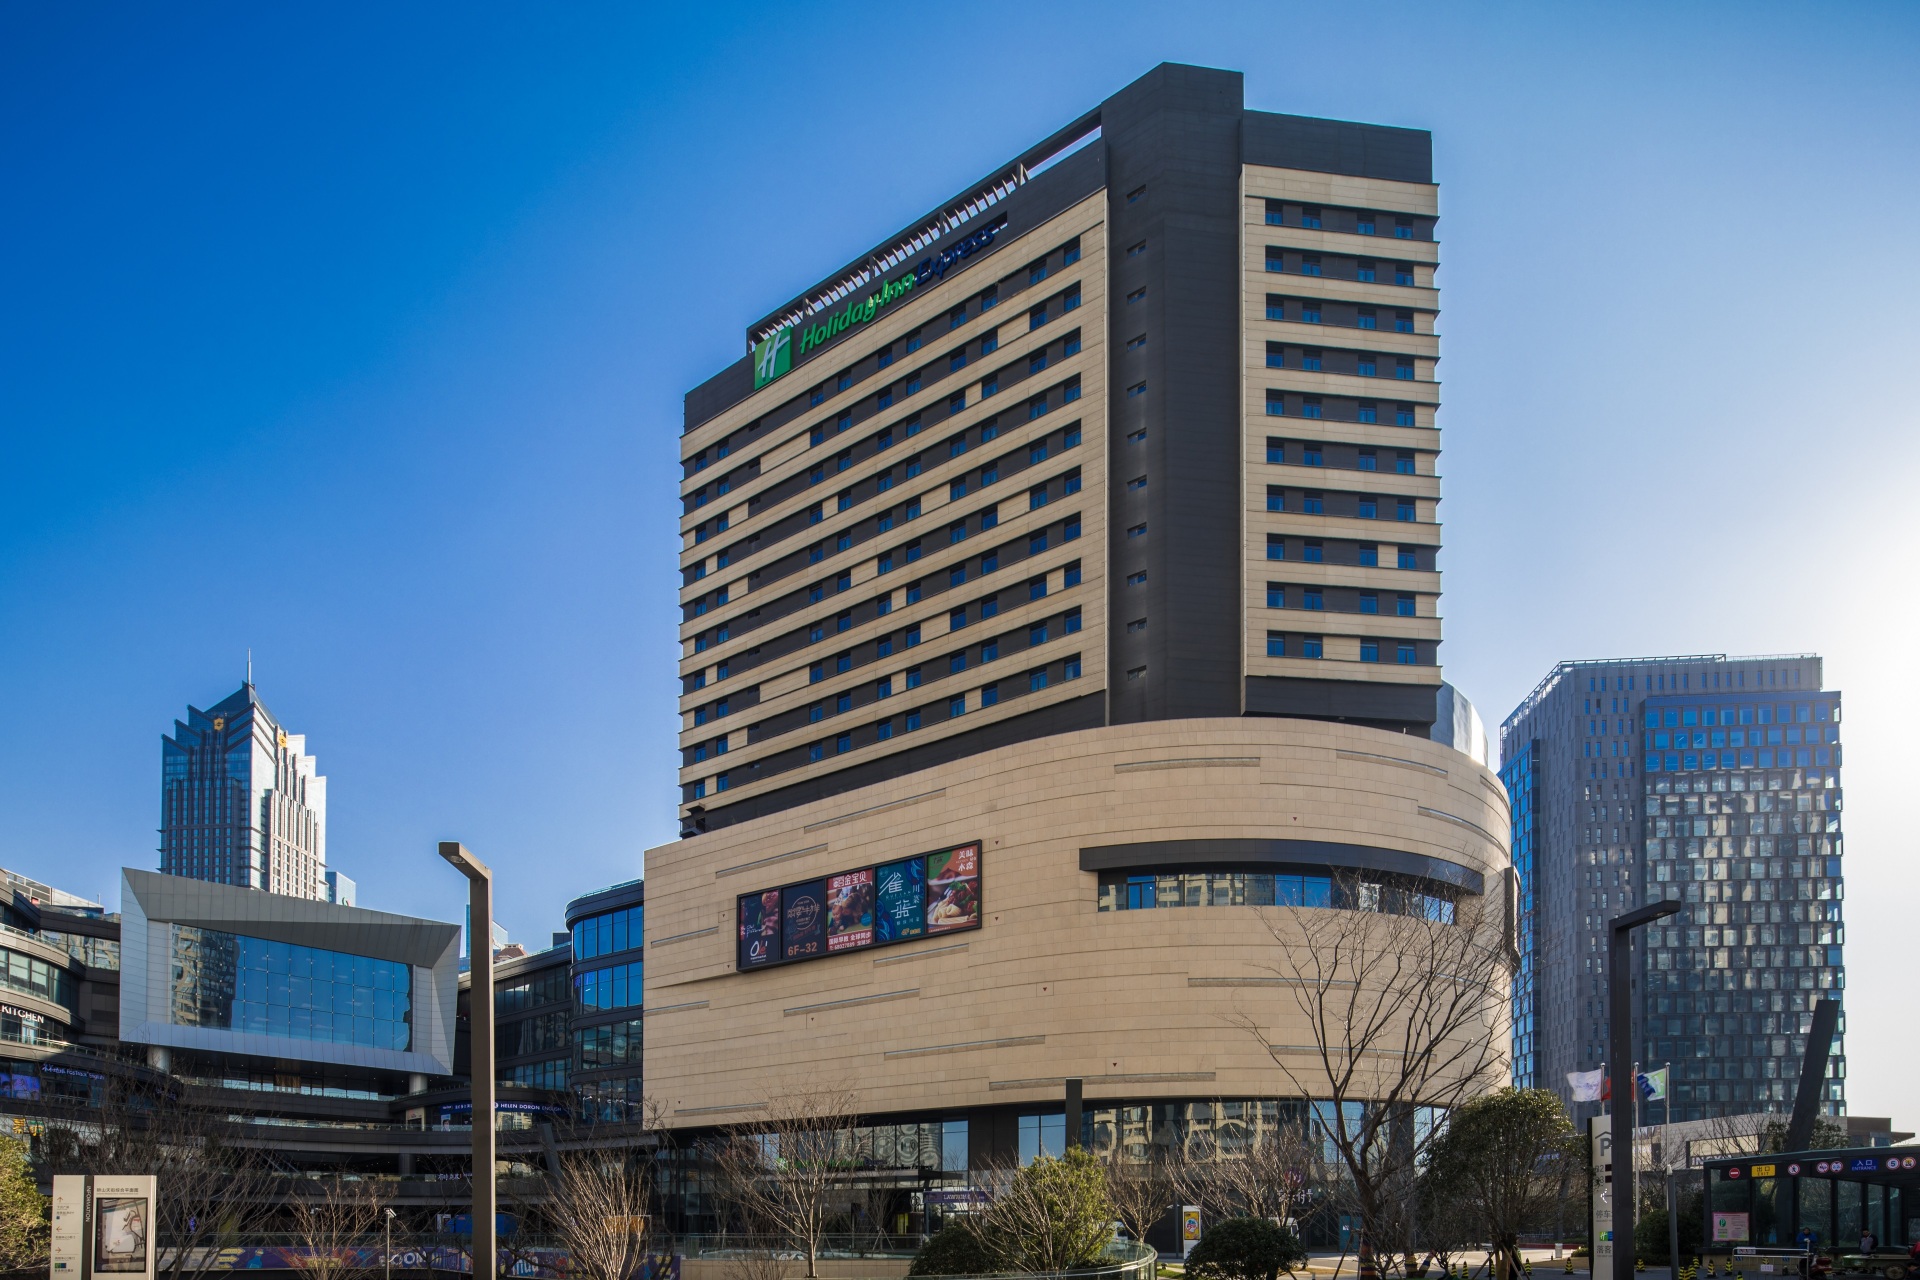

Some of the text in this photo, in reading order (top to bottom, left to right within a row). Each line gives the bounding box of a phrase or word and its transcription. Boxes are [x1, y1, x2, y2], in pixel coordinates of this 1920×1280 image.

[800, 224, 995, 354] Holiday Inn Express
[788, 942, 817, 956] 6F-32
[1, 1005, 44, 1024] KITCHEN
[1600, 1138, 1611, 1156] P
[1596, 1209, 1612, 1219] 停车
